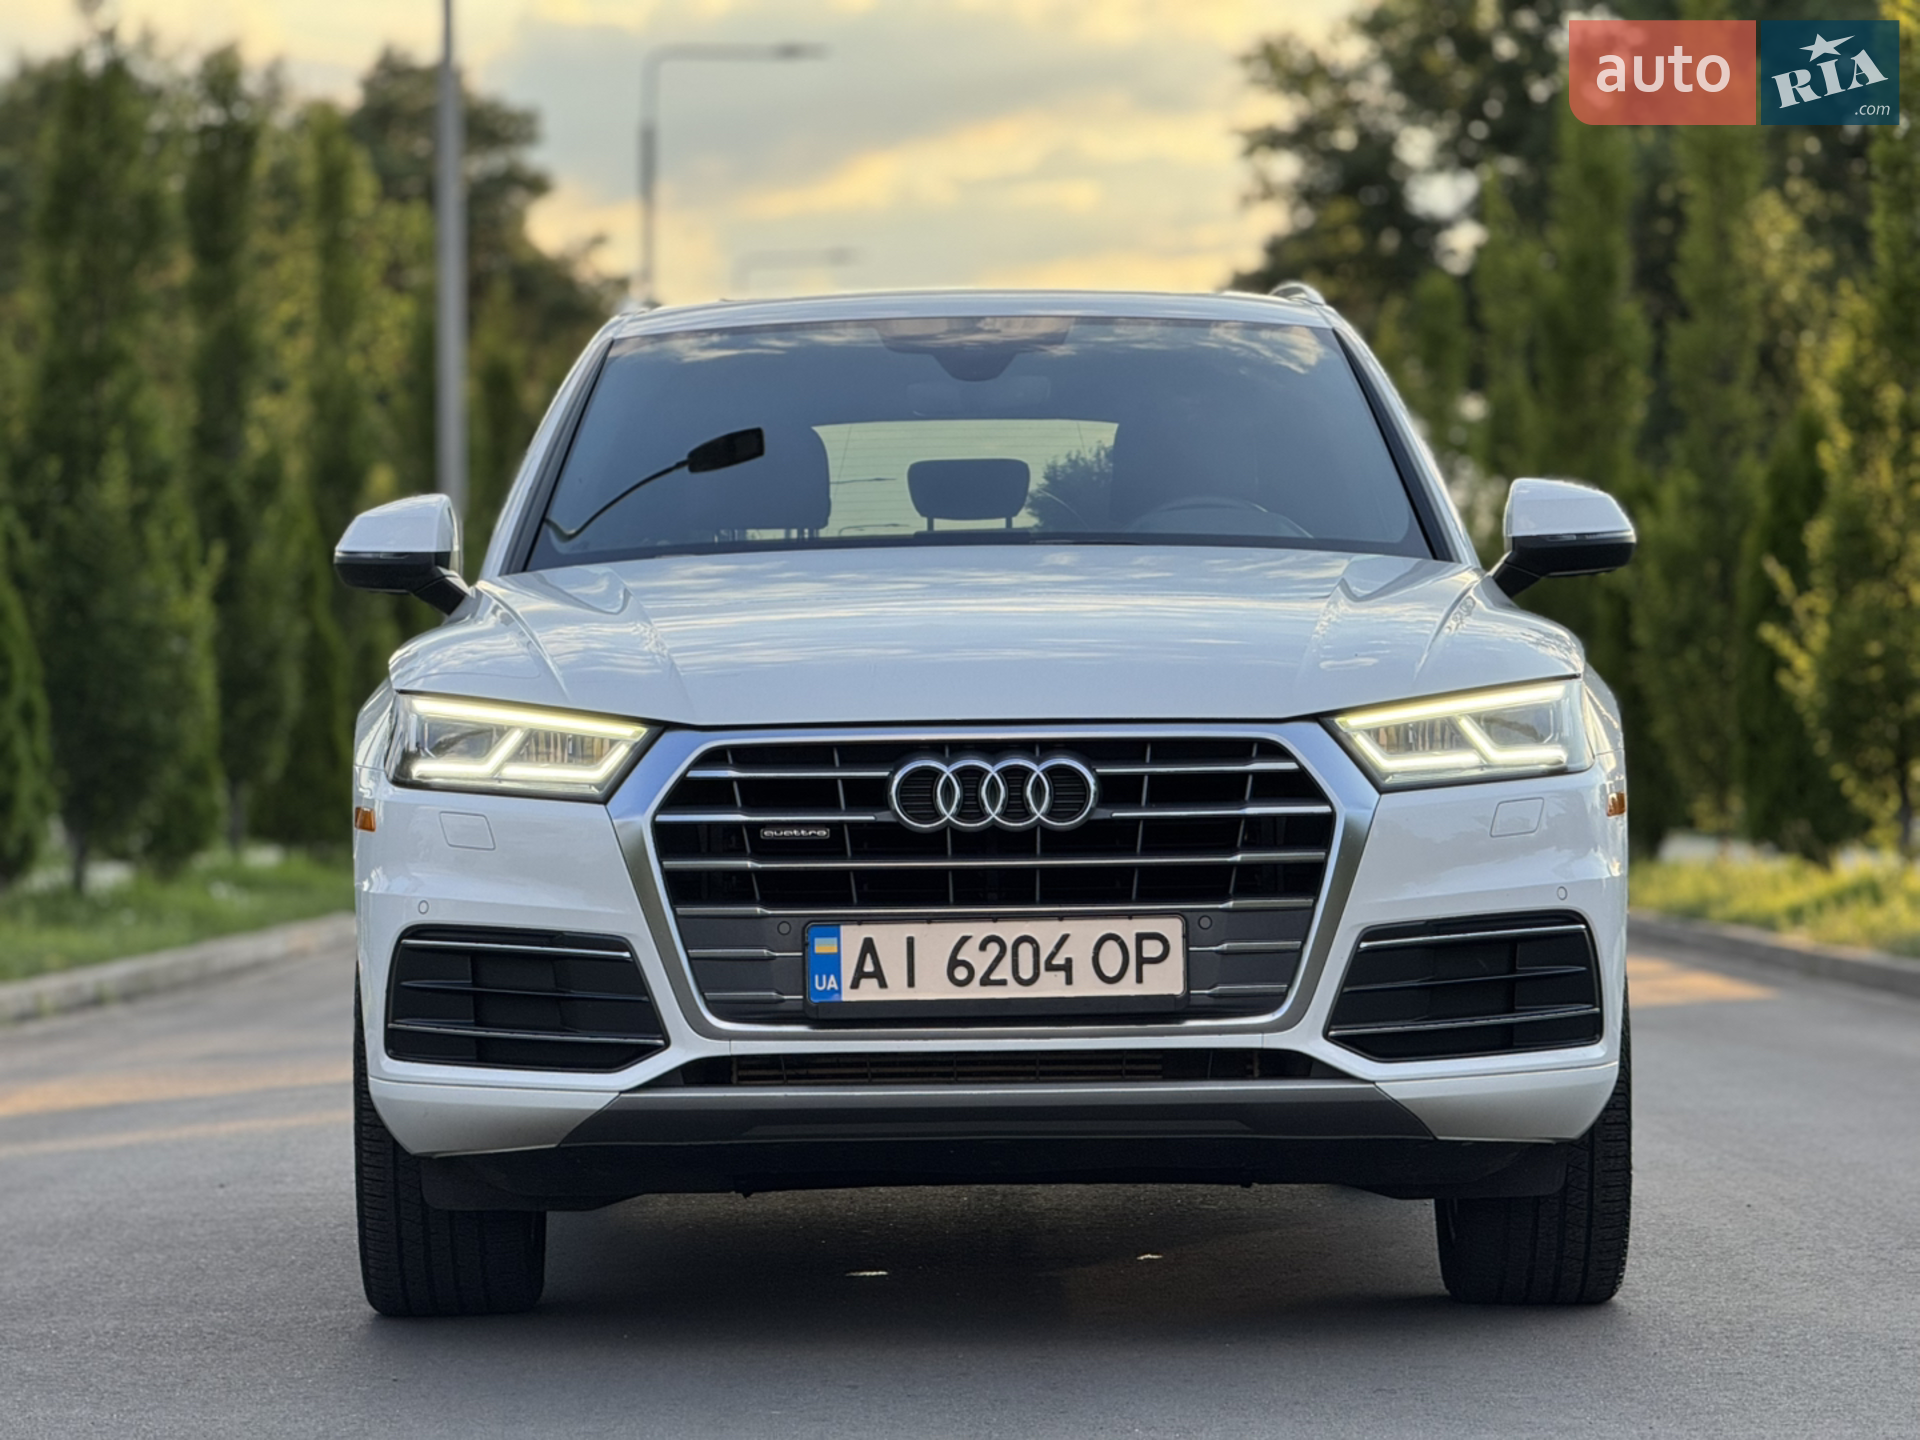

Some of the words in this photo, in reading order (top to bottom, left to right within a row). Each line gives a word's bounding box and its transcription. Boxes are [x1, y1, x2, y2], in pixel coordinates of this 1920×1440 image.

[762, 829, 828, 838] quattro
[849, 936, 915, 990] AI
[946, 933, 1073, 988] 6204
[1091, 932, 1171, 985] OP
[815, 974, 839, 991] UA
